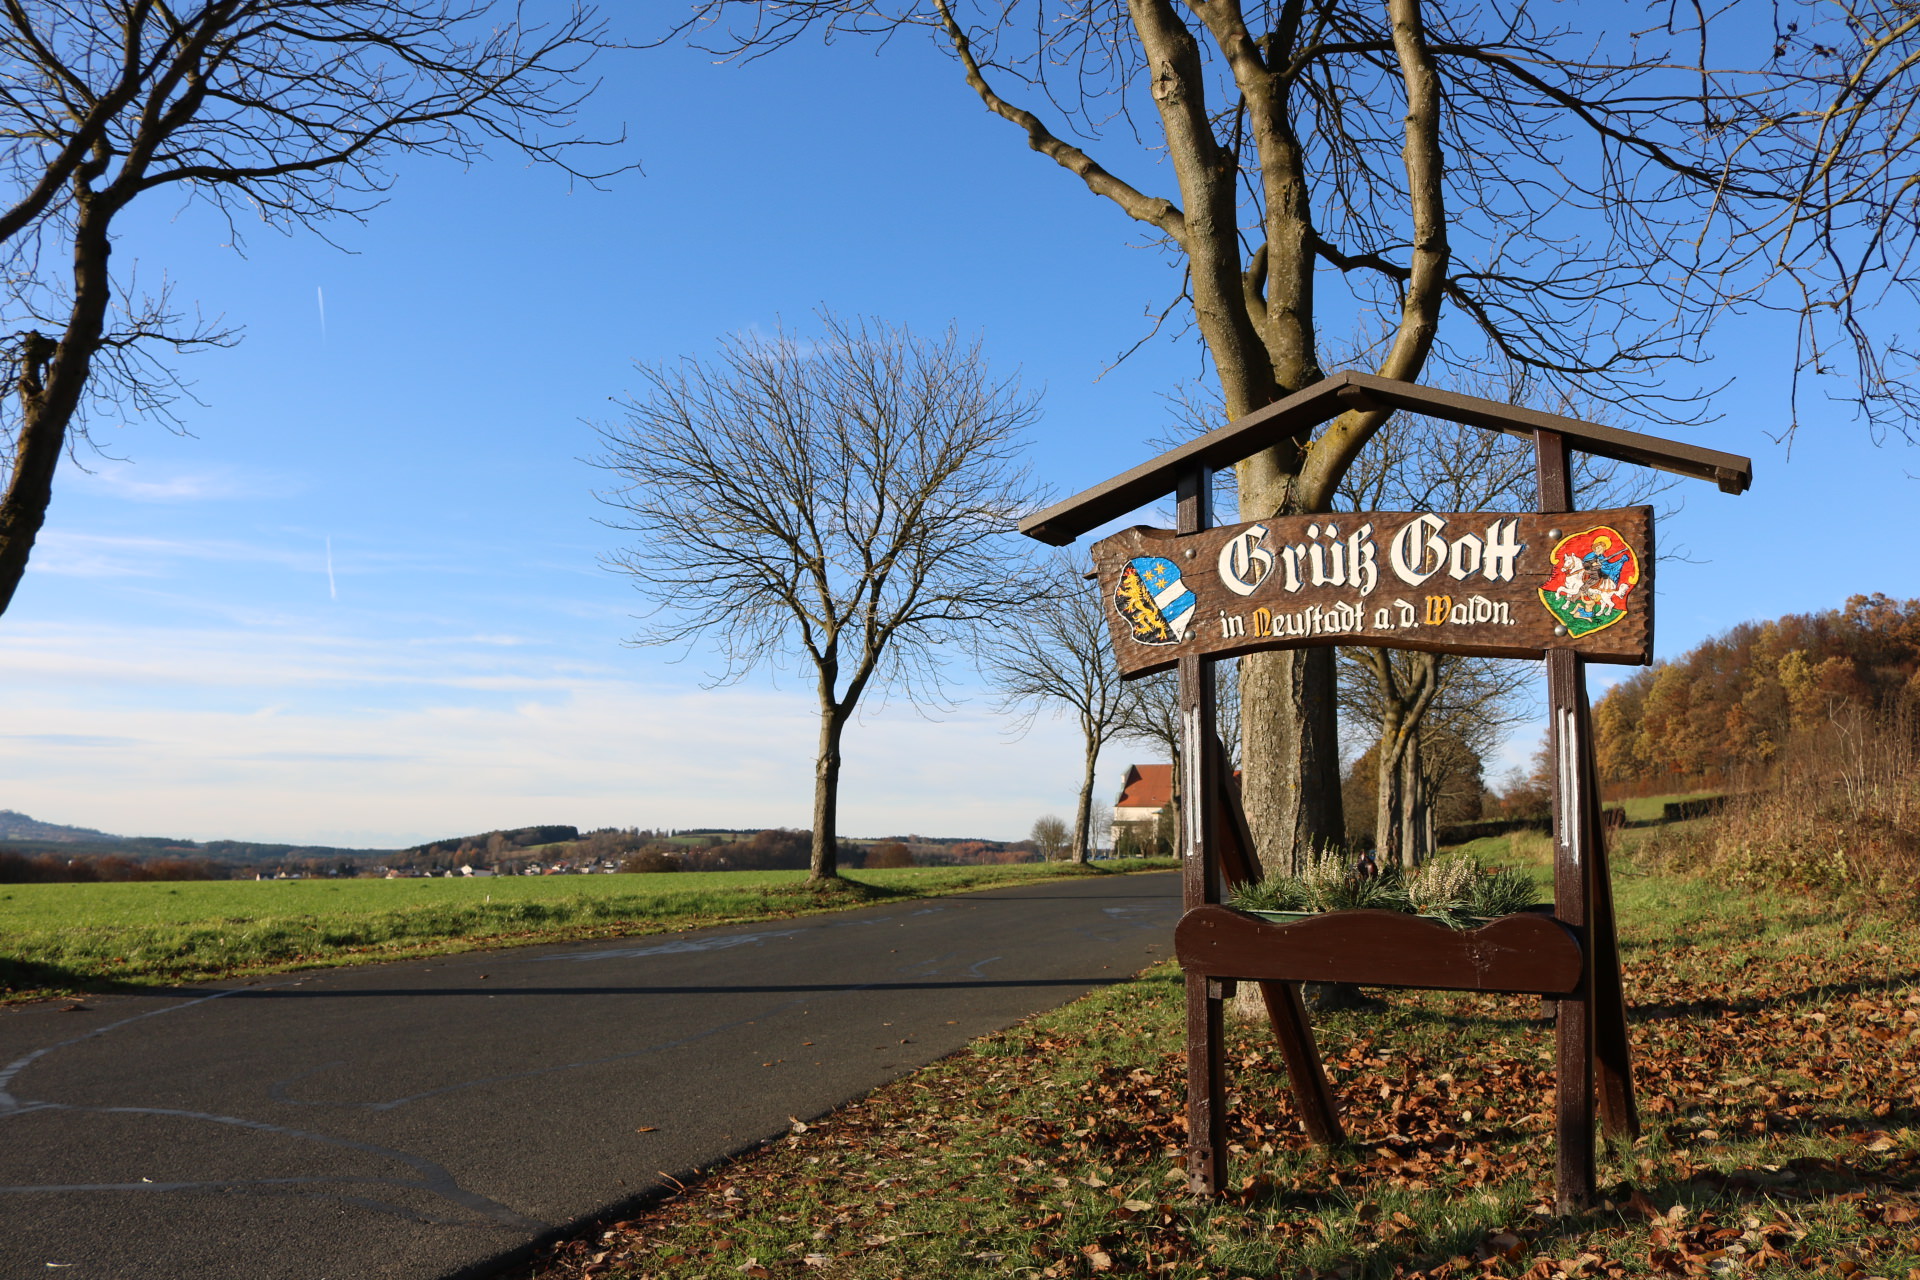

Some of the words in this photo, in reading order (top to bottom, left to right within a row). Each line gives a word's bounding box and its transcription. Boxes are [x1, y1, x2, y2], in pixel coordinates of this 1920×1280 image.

[1218, 523, 1379, 597] Grüß
[1390, 513, 1526, 587] Gott
[1220, 610, 1246, 638] in
[1424, 594, 1516, 627] Waldn.
